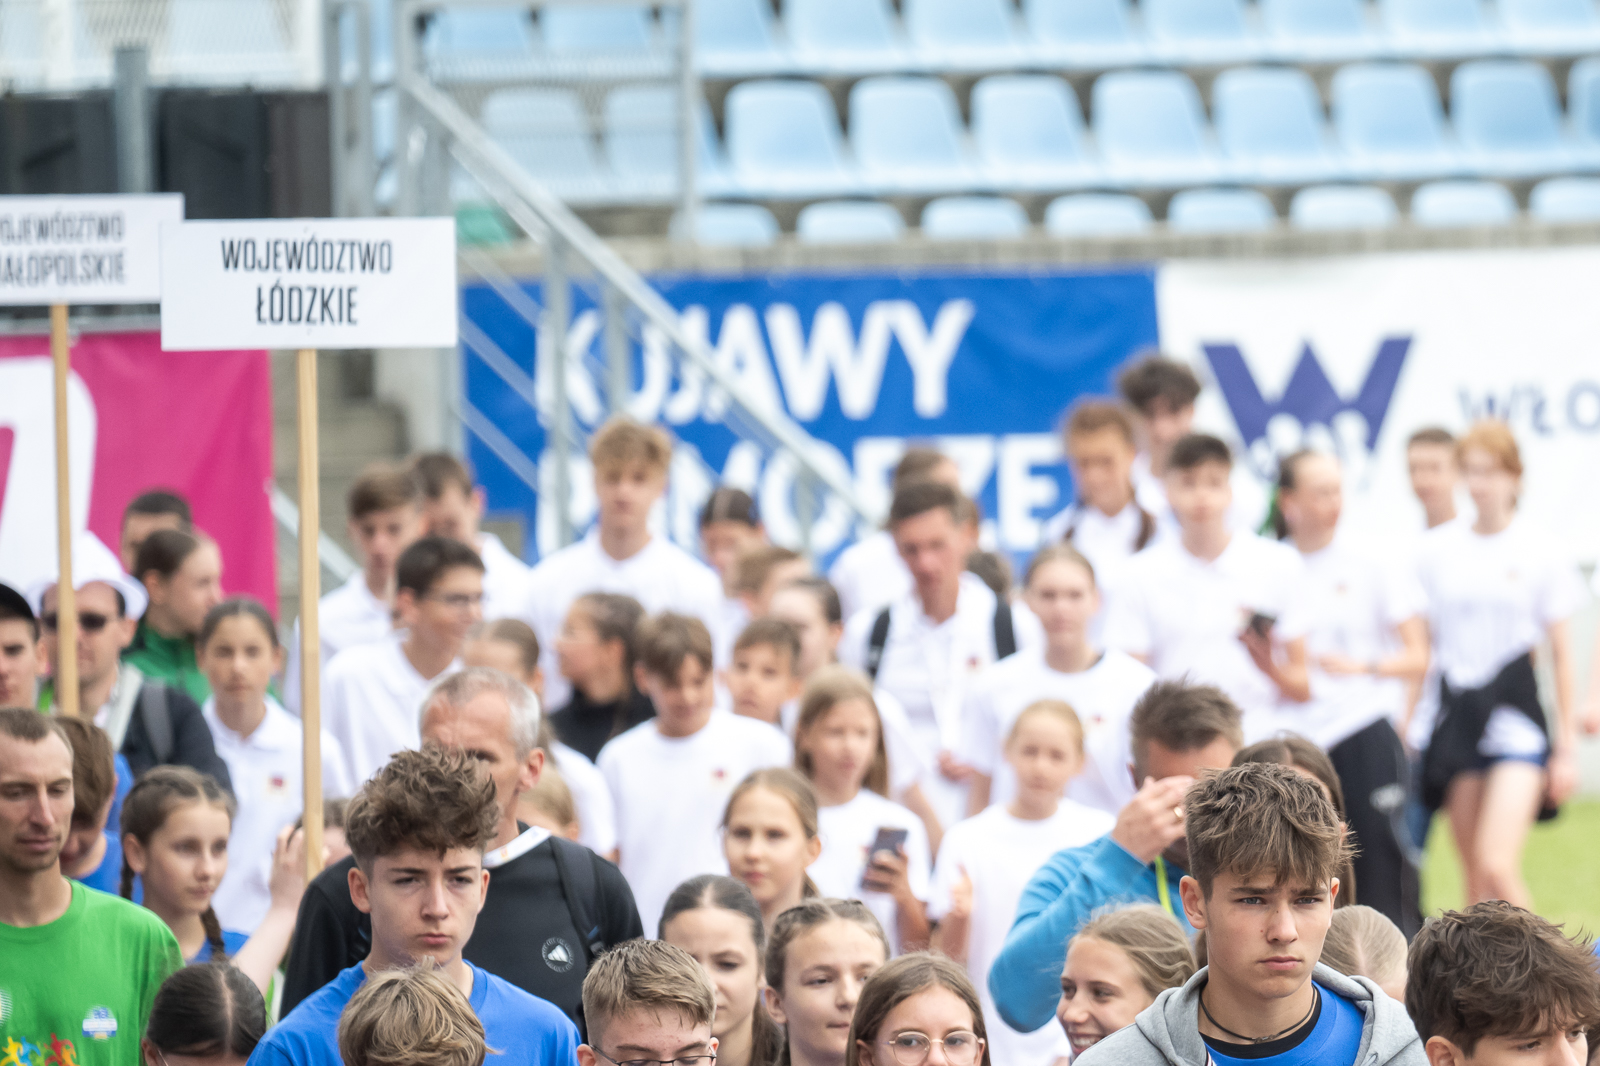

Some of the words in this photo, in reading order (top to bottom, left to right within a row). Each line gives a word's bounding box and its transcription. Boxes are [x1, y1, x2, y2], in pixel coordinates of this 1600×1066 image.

[0, 205, 124, 244] OJEWÓDZTWO
[0, 249, 125, 287] AŁOPOLSKIE
[221, 233, 393, 273] WOJEWÓDZTWO
[256, 278, 359, 325] ŁÓDZKIE
